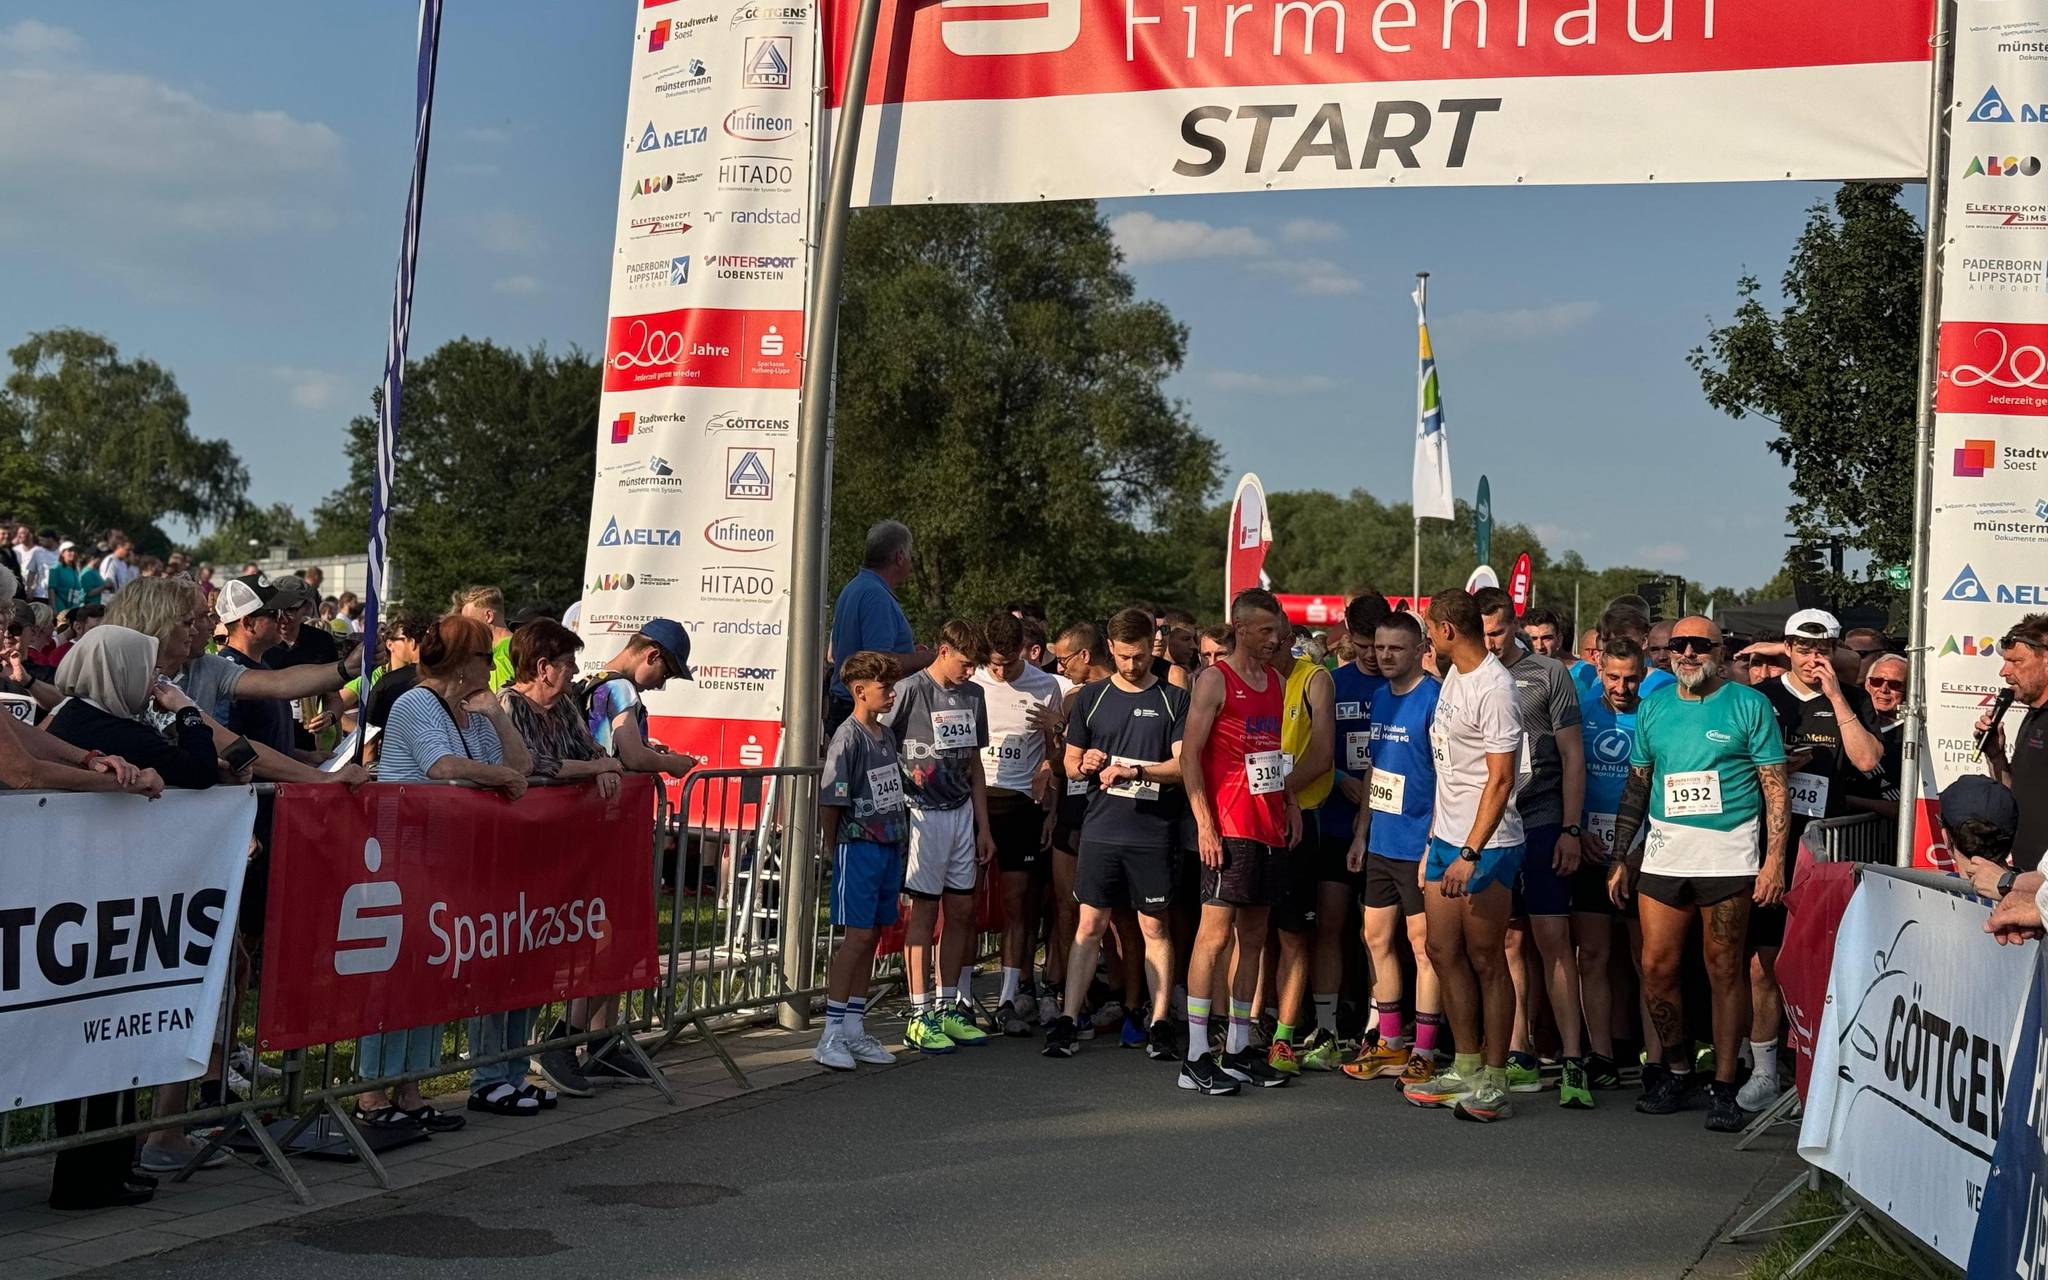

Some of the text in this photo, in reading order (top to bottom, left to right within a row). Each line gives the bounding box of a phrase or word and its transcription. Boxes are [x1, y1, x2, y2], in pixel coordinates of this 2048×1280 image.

[675, 14, 719, 30] Stadtwerke
[674, 29, 693, 40] Soest
[655, 76, 712, 93] münstermann
[749, 74, 785, 85] ALDI
[663, 126, 708, 149] DELTA
[1172, 97, 1502, 177] START
[719, 164, 793, 185] HITADO
[1962, 155, 2042, 180] ALSO
[630, 174, 673, 200] ALSO
[731, 208, 801, 224] randstad
[626, 259, 670, 274] PADERBORN
[718, 255, 796, 269] INTERSPORT
[1962, 258, 2042, 271] PADERBORN
[629, 270, 669, 284] LIPPSTADT
[717, 270, 784, 280] LOBENSTEIN
[1969, 272, 2042, 284] LIPPSTADT
[1968, 284, 2041, 292] AIRPORT
[614, 319, 730, 371] 200 Jahre
[673, 369, 700, 378] wieder!
[1988, 394, 2033, 405] Jederzeit
[639, 412, 686, 425] Stadtwerke
[726, 415, 789, 430] GÖTTGENS
[637, 425, 654, 435] Soest
[2003, 459, 2038, 471] Soest
[618, 477, 682, 488] münstermann
[733, 485, 766, 495] ALDI
[624, 529, 681, 547] DELTA
[1994, 534, 2036, 543] Dokumente
[590, 573, 635, 595] ALSO
[701, 575, 774, 595] HITADO
[713, 618, 782, 636] randstad
[700, 665, 777, 680] INTERSPORT
[699, 680, 764, 692] LOBENSTEIN
[941, 723, 972, 738] 2434
[987, 746, 1022, 760] 4198
[1255, 765, 1280, 781] 3194
[877, 778, 899, 796] 2445
[1672, 787, 1712, 803] 1932
[427, 892, 606, 979] Sparkasse
[84, 1018, 112, 1044] WE
[115, 1012, 153, 1041] ARE
[1966, 1178, 1982, 1214] WE
